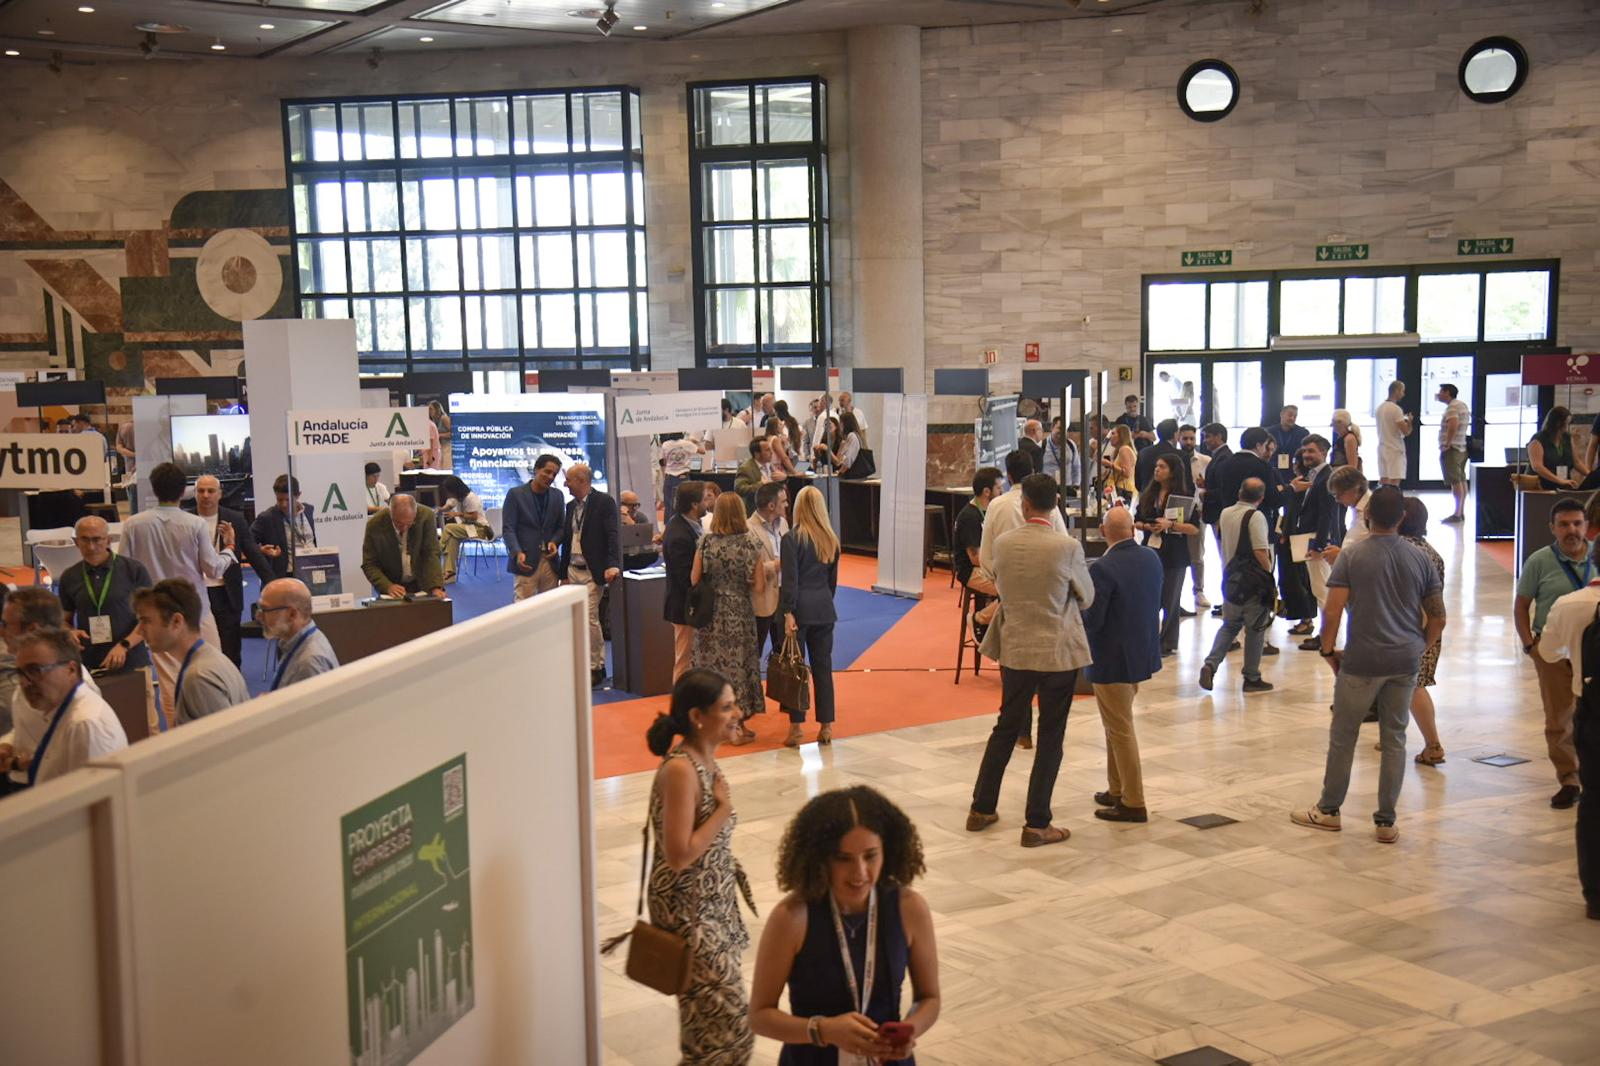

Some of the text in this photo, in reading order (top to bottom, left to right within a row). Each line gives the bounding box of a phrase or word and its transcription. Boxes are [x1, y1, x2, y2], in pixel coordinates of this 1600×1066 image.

[486, 424, 514, 432] PÚBLICA
[303, 433, 350, 445] TRADE
[542, 431, 578, 439] INNOVACIÓN
[471, 446, 525, 457] Apoyamos
[526, 446, 537, 455] tu
[469, 458, 529, 470] financiamos
[348, 803, 413, 856] PROYECTA
